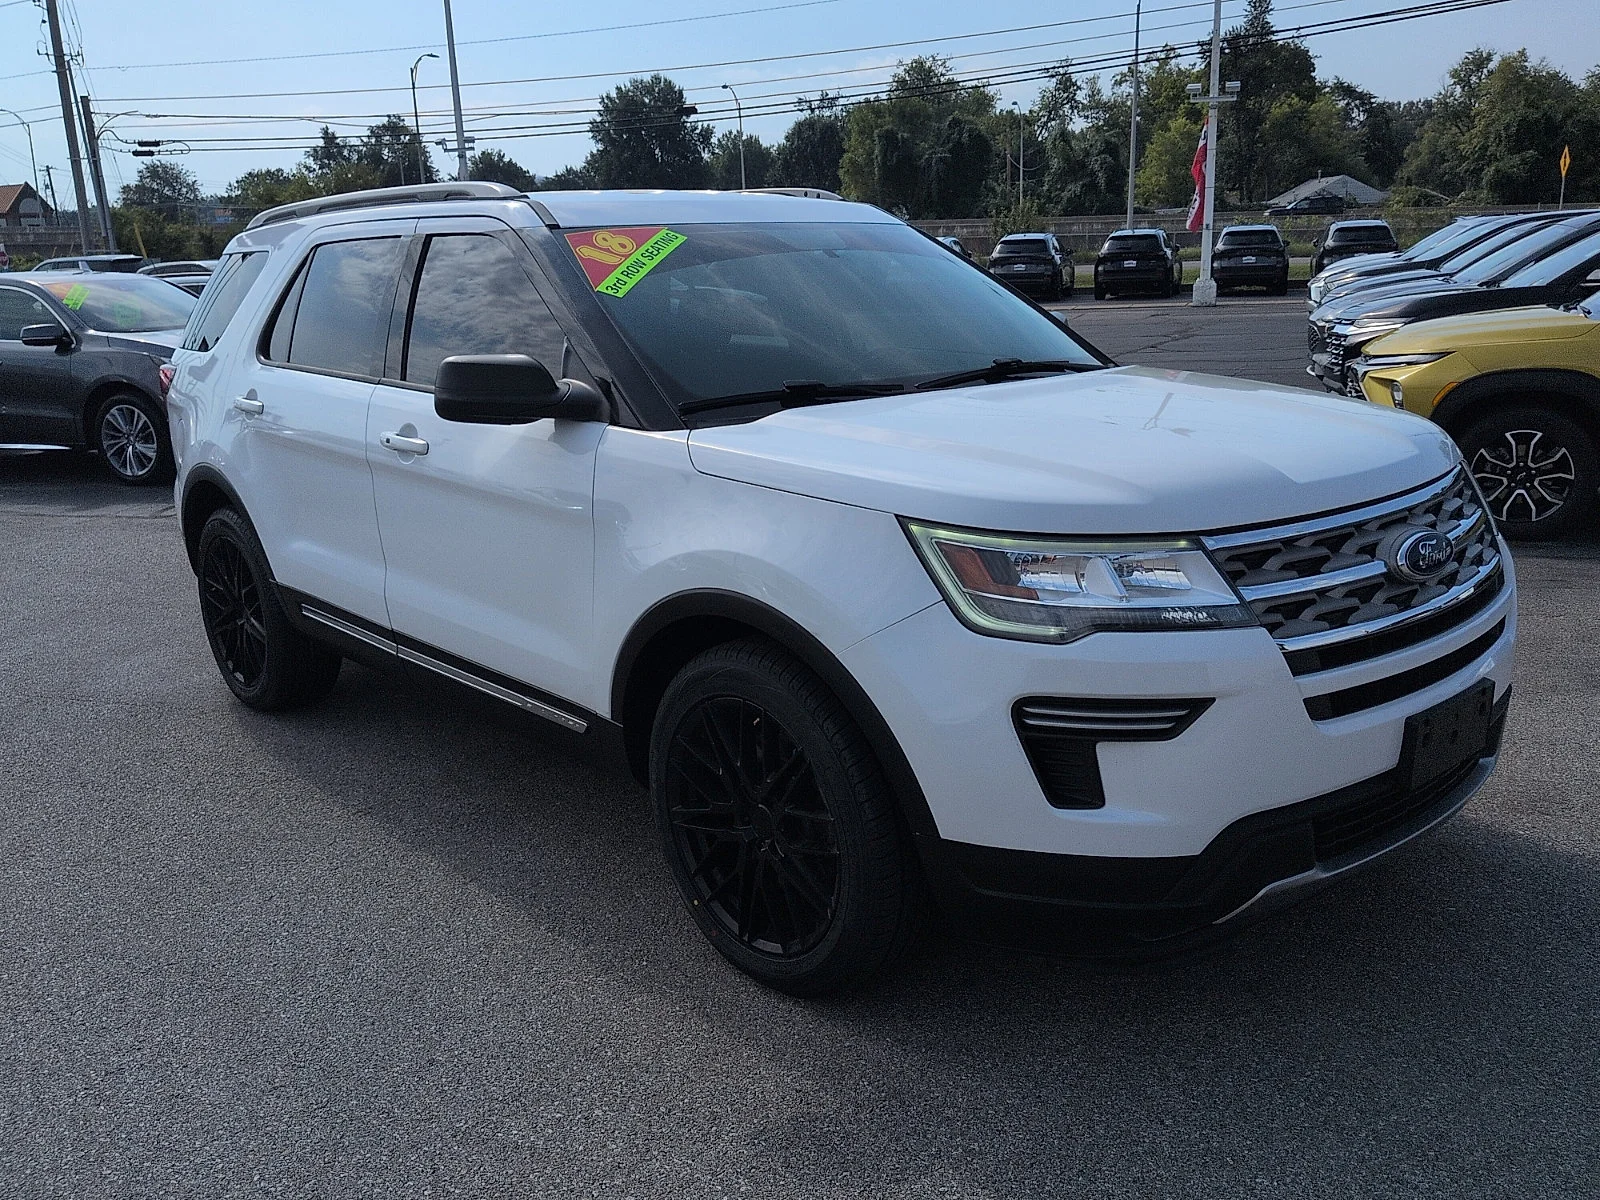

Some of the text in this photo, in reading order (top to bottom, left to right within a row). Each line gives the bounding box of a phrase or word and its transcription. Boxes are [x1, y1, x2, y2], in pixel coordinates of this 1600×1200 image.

[576, 231, 636, 264] 18
[605, 232, 678, 294] 3rd ROW SEATING
[1419, 538, 1451, 569] Ford
